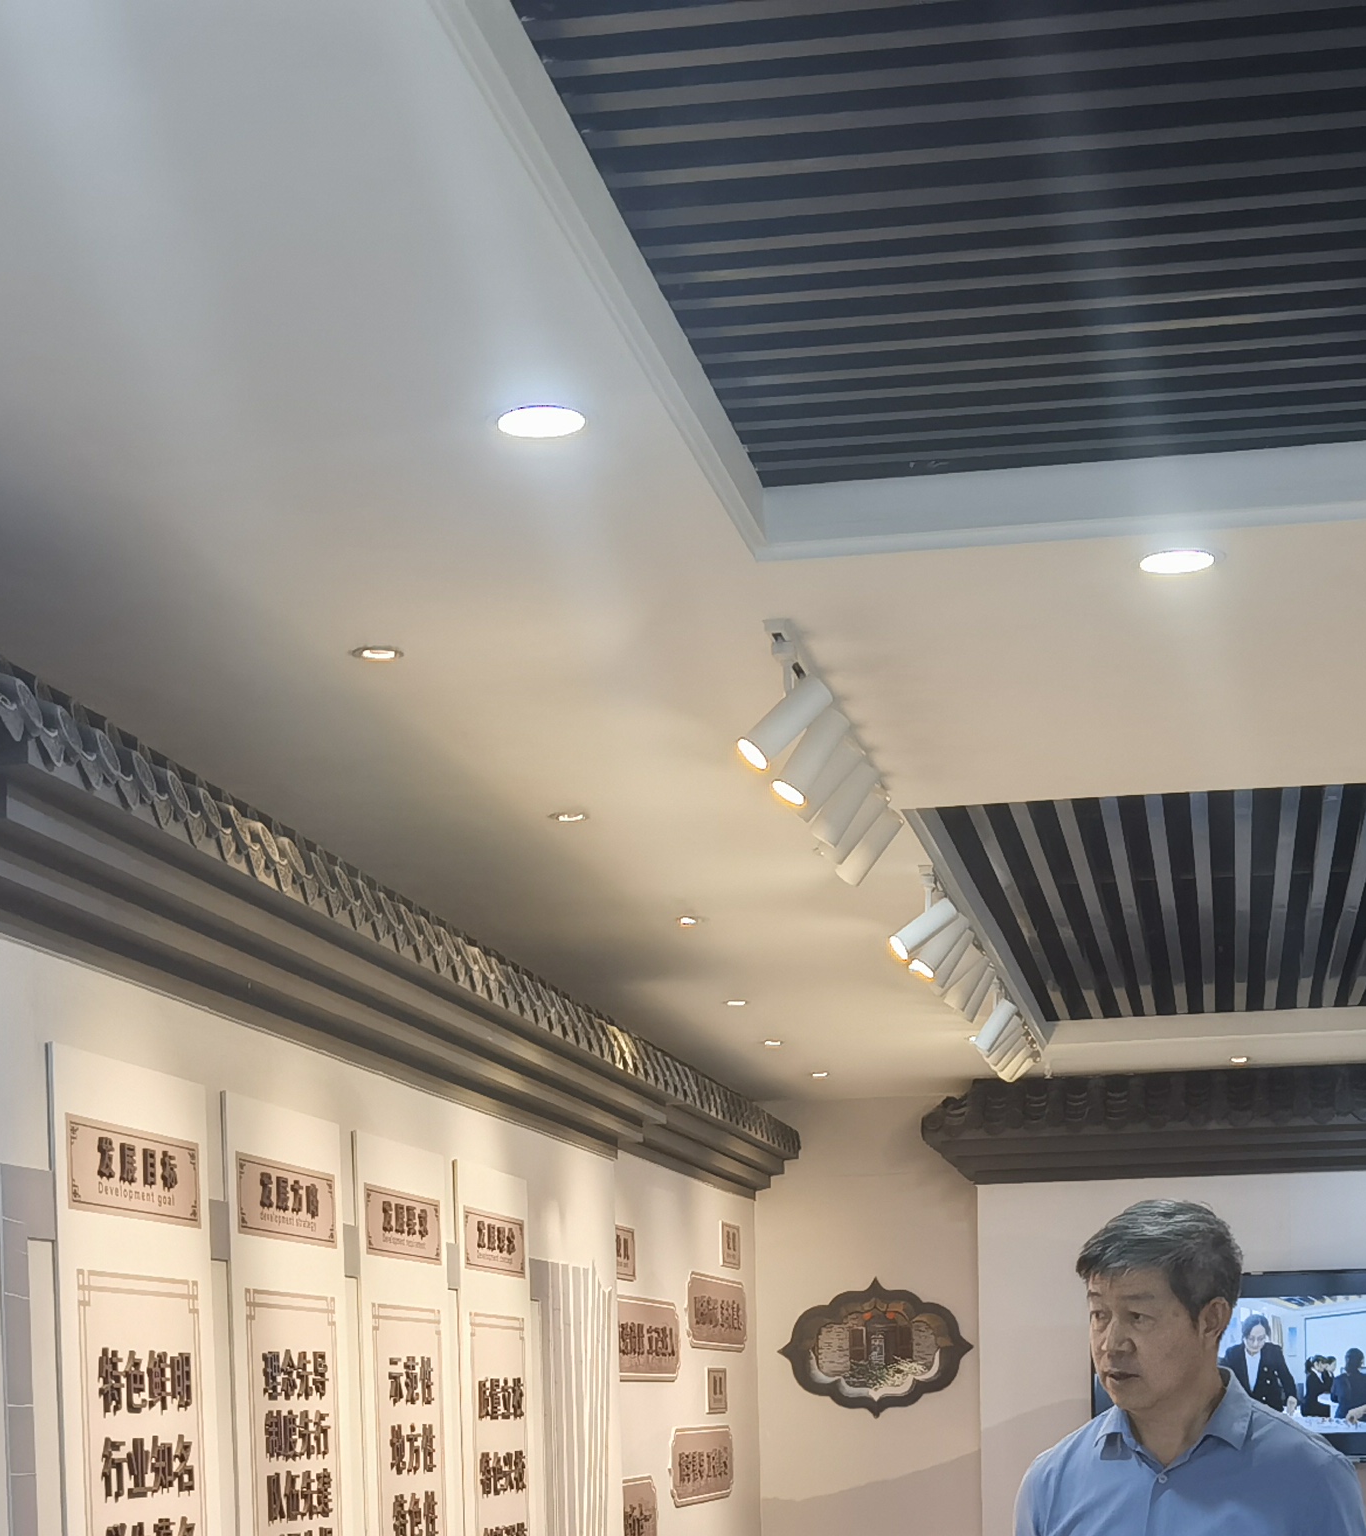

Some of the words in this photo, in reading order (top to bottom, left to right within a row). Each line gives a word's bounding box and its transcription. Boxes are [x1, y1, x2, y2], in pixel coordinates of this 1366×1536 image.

[97, 1137, 178, 1192] 发展目标
[98, 1181, 155, 1202] Development
[157, 1193, 176, 1207] goal
[99, 1347, 192, 1418] 特色鲜明
[262, 1349, 329, 1401] 理念先导
[388, 1355, 435, 1407] 示范性
[478, 1377, 524, 1421] 质量立校
[265, 1409, 331, 1462] 制度先行
[390, 1422, 437, 1475] 地方性
[101, 1434, 195, 1502] 行业知名
[480, 1450, 526, 1498] 特色兴校
[267, 1468, 333, 1527] 队伍先建
